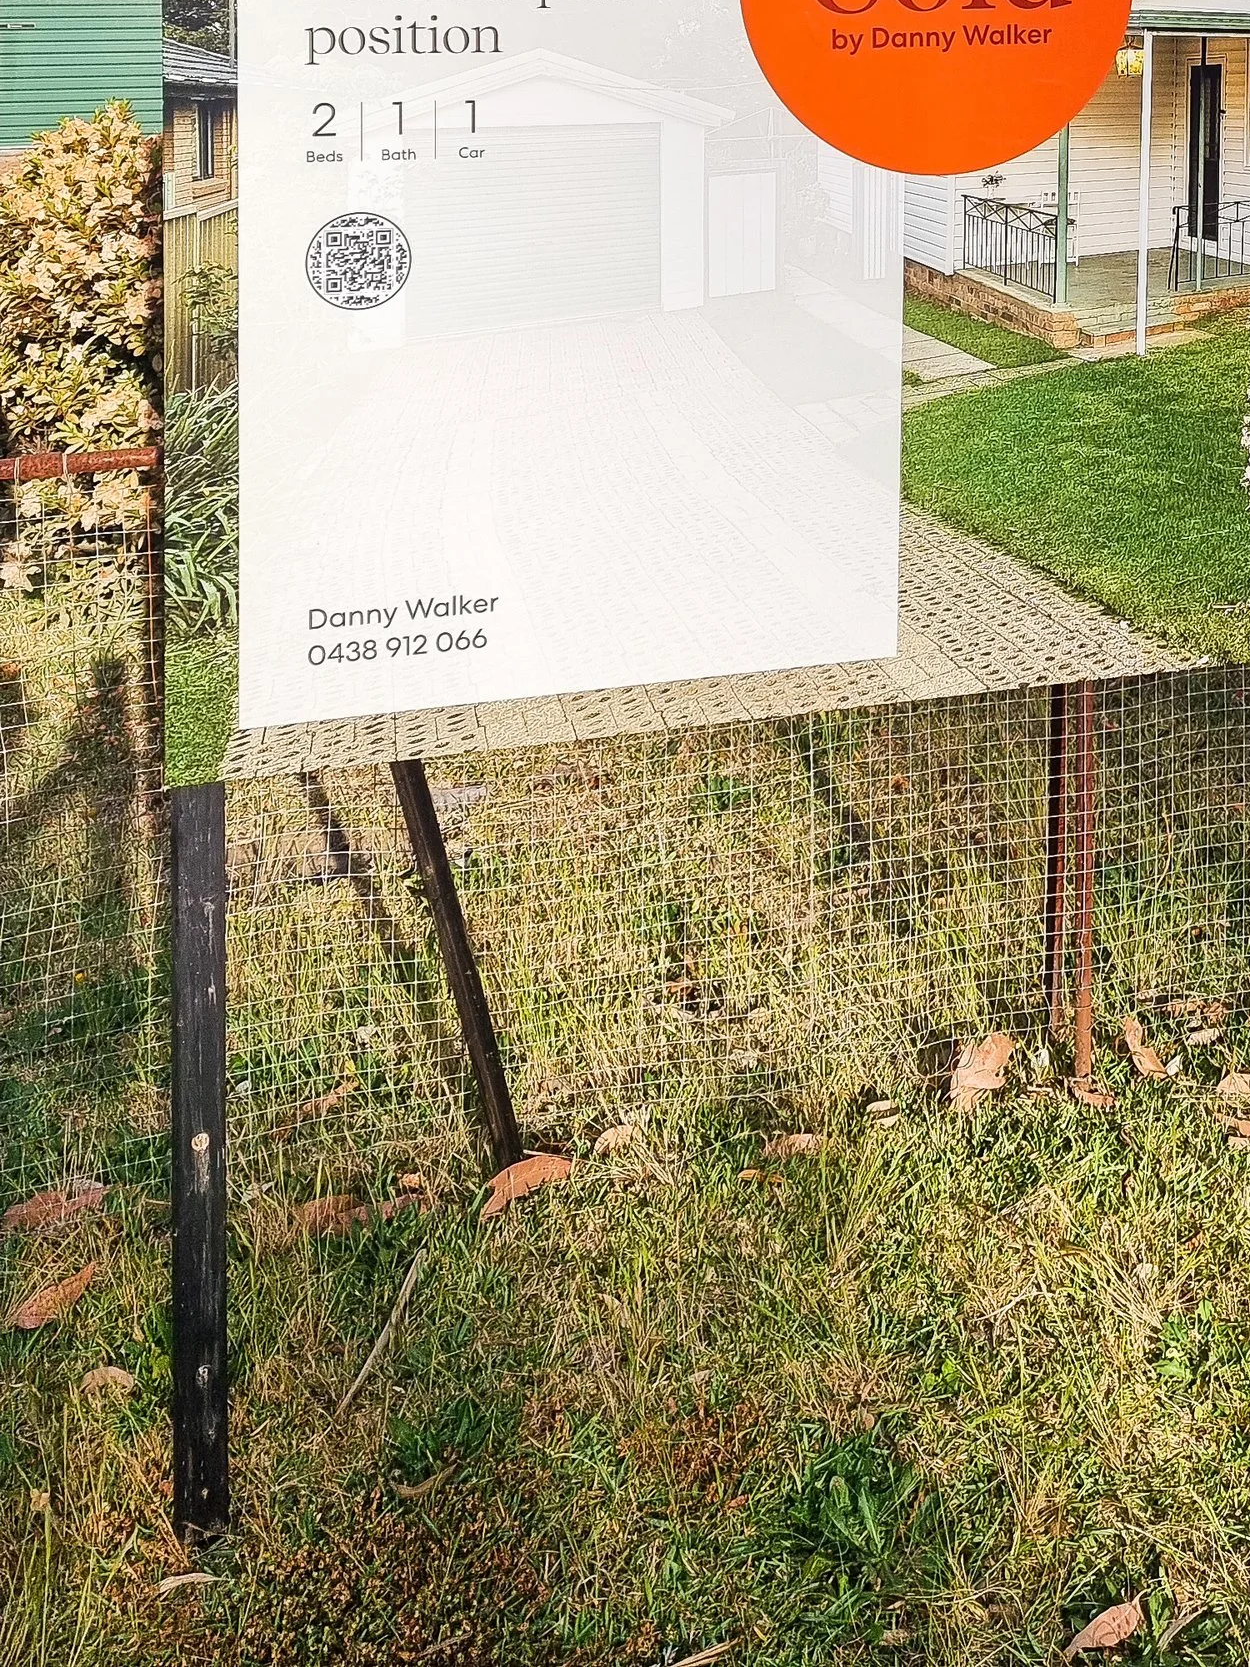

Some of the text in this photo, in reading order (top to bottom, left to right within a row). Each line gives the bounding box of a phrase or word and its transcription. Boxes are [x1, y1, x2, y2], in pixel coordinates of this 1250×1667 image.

[305, 14, 502, 65] position
[831, 24, 1053, 55] by Danny Walker
[312, 102, 337, 137] 2
[392, 101, 403, 135] 1
[465, 100, 476, 134] 1
[306, 151, 344, 163] Beds
[381, 149, 417, 161] Bath
[458, 147, 486, 159] Car
[308, 595, 499, 630] Danny Walker
[307, 628, 488, 666] 0438 912 066
